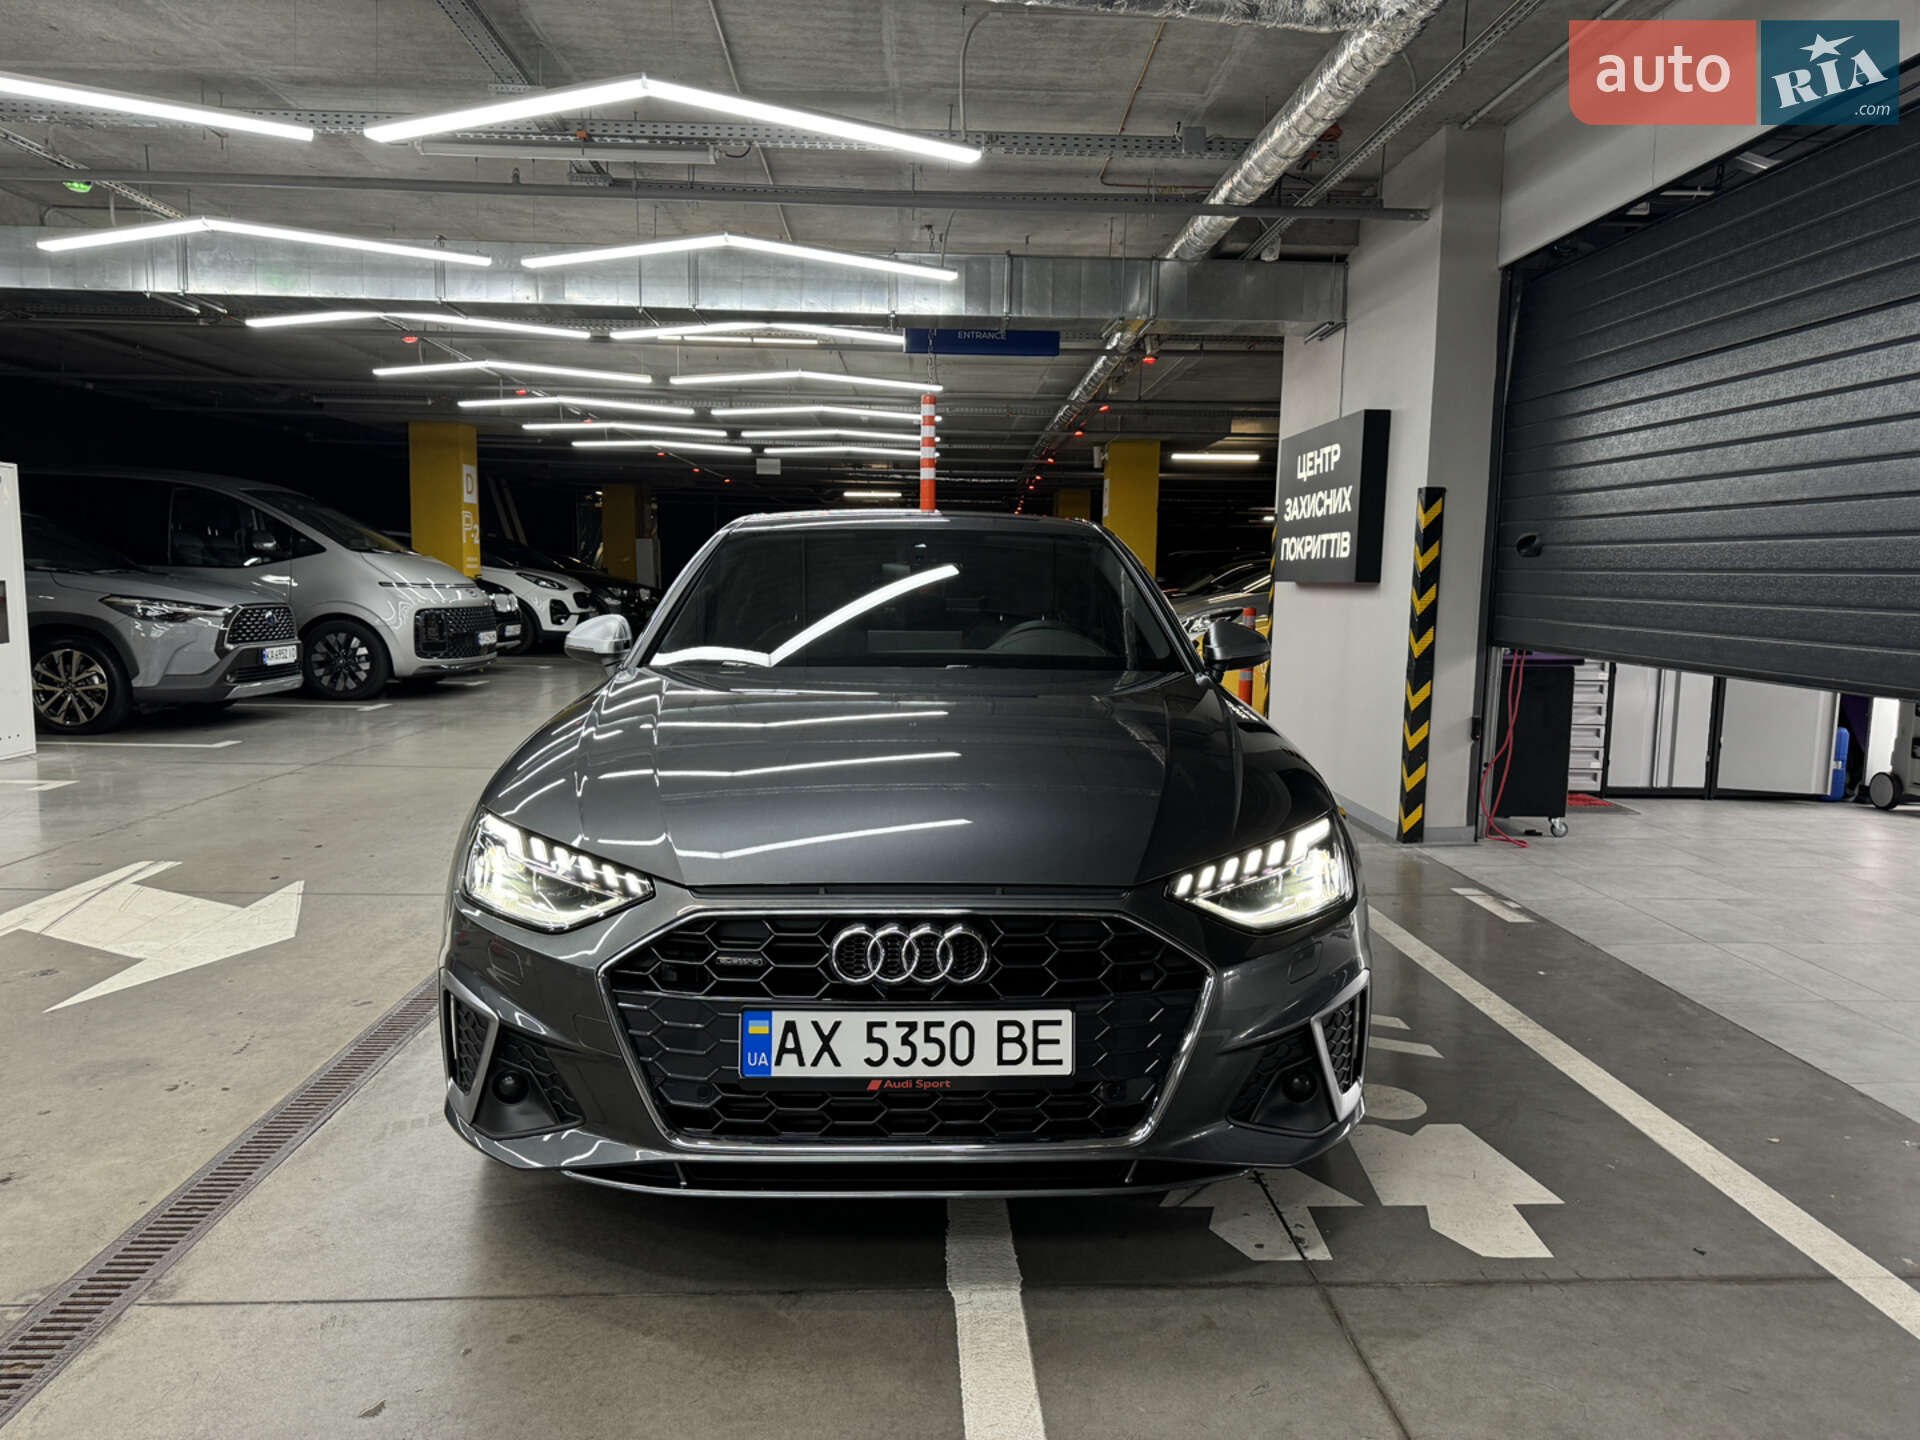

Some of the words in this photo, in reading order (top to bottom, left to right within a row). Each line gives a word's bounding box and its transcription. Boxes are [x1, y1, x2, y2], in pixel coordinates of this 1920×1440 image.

[957, 330, 1007, 341] ENTRANCE
[1297, 443, 1341, 482] ЦЕНТР
[1284, 485, 1353, 522] ЗАХИСНИХ
[1280, 531, 1351, 561] ПОКРИТТІВ
[774, 1020, 842, 1067] AX
[863, 1020, 975, 1067] 5350
[997, 1019, 1063, 1066] BE
[747, 1051, 769, 1067] UA
[883, 1079, 912, 1088] Audi
[915, 1079, 951, 1090] Sport
